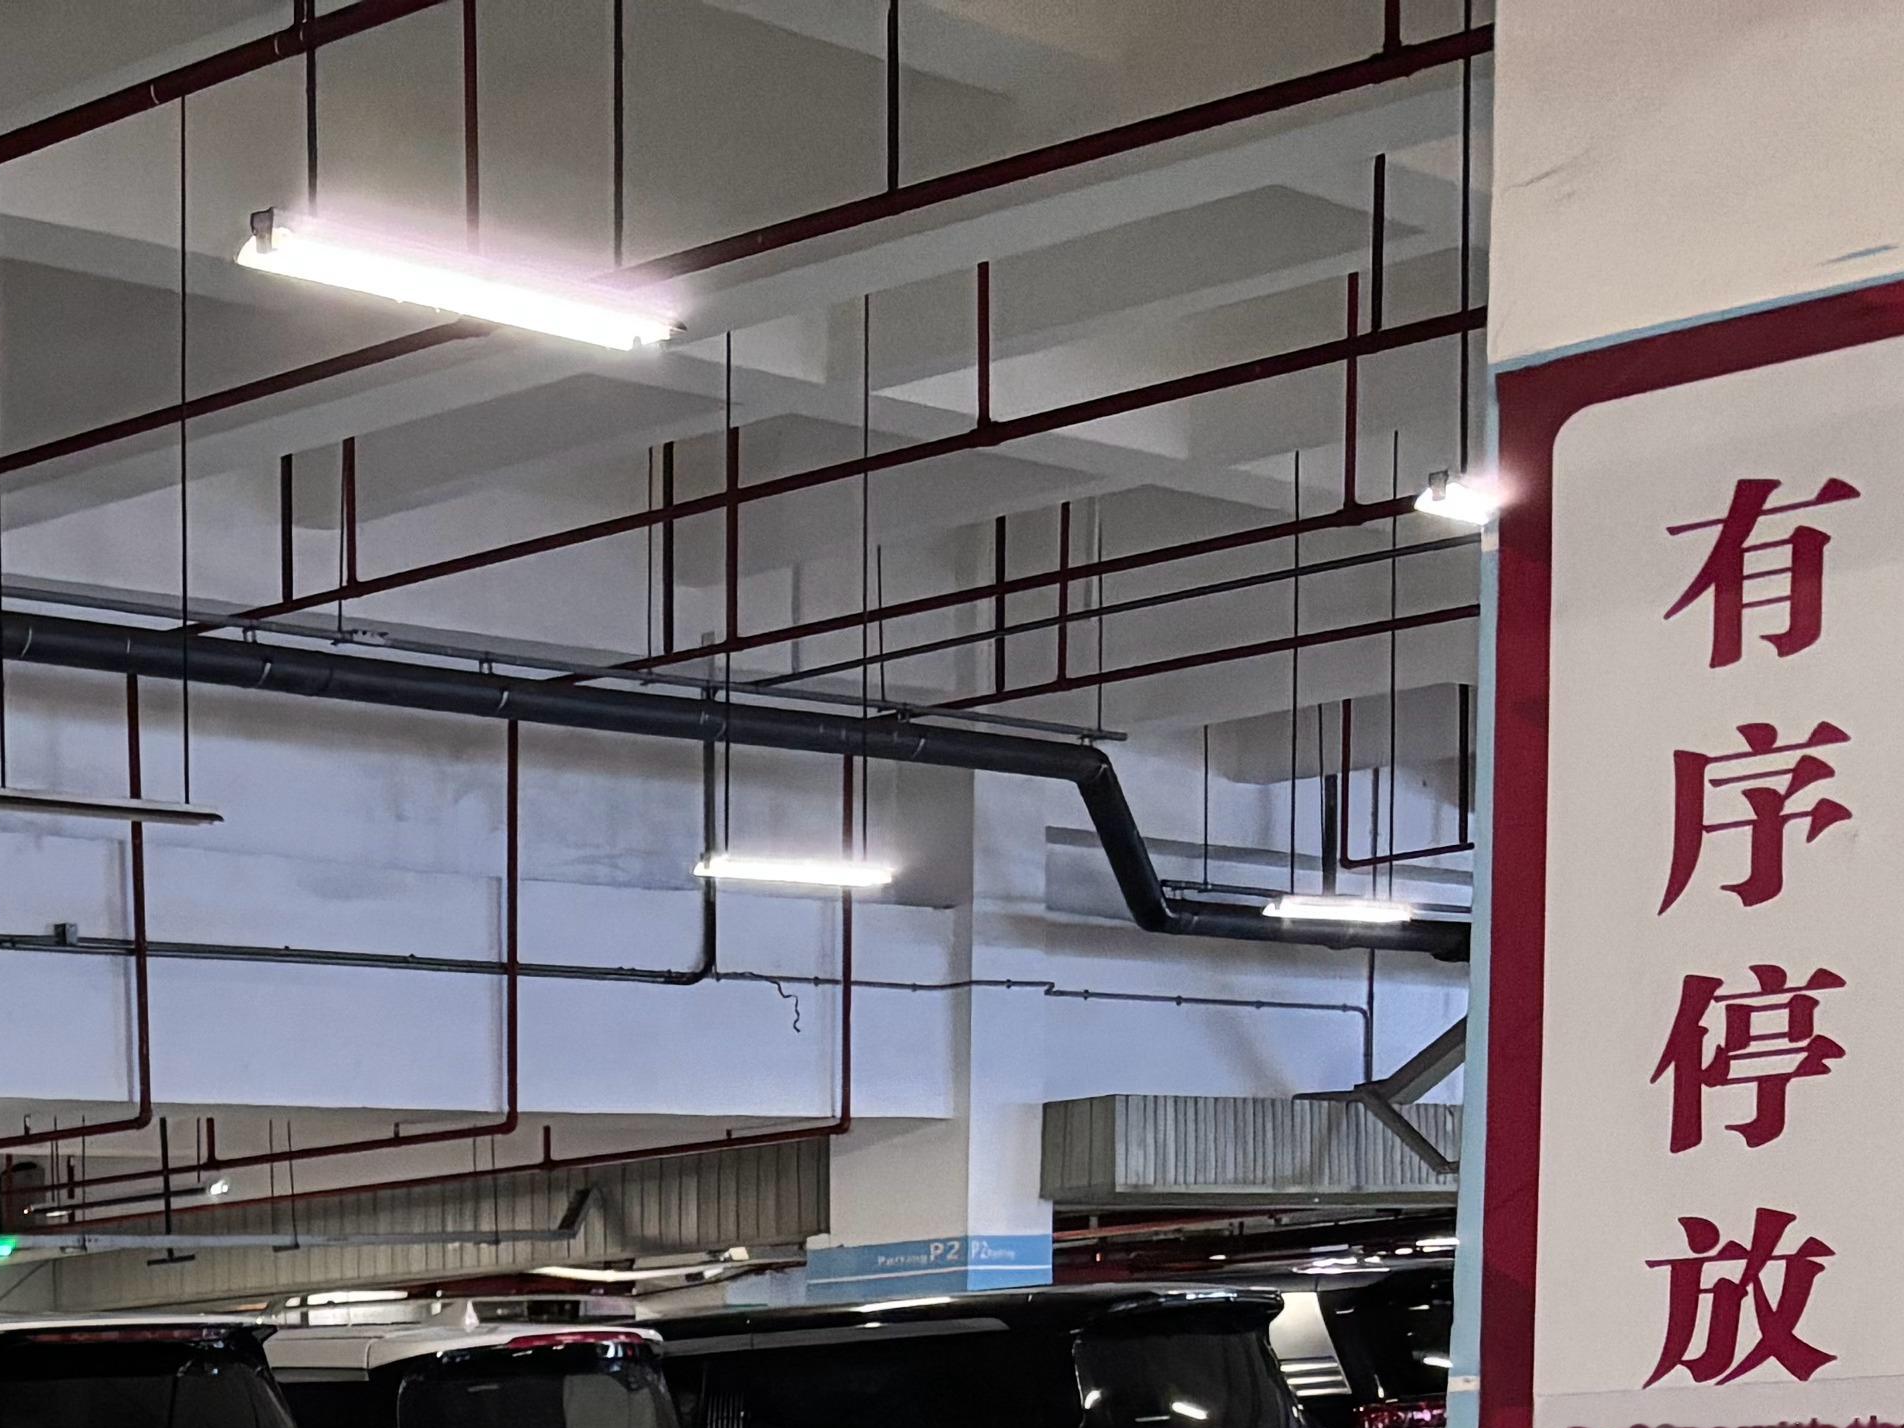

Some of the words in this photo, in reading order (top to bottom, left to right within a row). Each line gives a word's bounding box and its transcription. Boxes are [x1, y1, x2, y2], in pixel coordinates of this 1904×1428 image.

[1642, 477, 1863, 1391] 有序停放
[930, 1240, 961, 1262] P2
